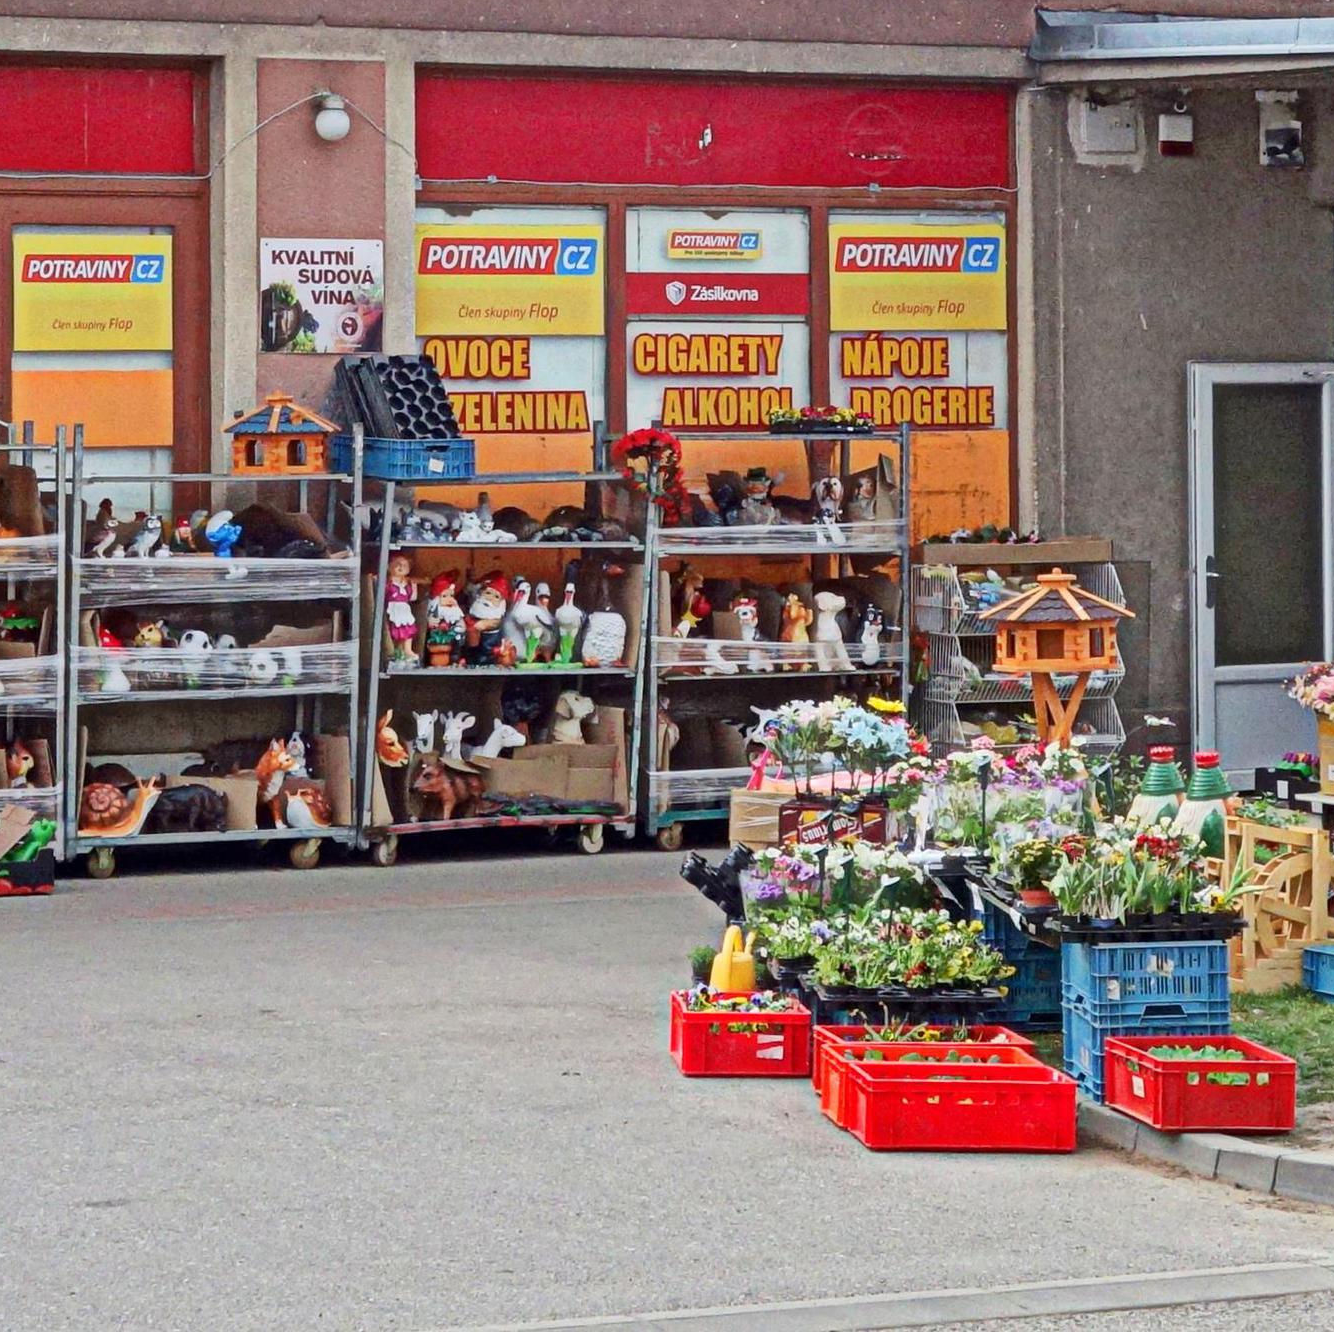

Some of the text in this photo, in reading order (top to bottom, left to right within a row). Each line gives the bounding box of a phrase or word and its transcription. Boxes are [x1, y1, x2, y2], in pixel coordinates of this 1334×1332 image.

[674, 235, 756, 247] POTRAVINY CZ
[271, 246, 354, 265] KVALITNÍ
[428, 245, 592, 269] POTRAVINY CZ
[843, 244, 995, 267] POTRAVINY CZ
[28, 260, 160, 279] POTRAVINY CZ
[298, 265, 374, 284] SUDOVÁ
[311, 285, 356, 305] VÍNA
[690, 285, 759, 301] Zásilkovna
[458, 303, 558, 322] Člen skupiny Flop
[872, 299, 965, 317] Člen skupiny Flop
[52, 318, 133, 332] Člen skupiny Flop
[424, 337, 531, 379] OVOCE
[634, 334, 782, 375] CIGARETY
[841, 332, 949, 378] NÁPOJE
[448, 391, 590, 433] ZELENINA
[850, 386, 994, 426] DROGERIE
